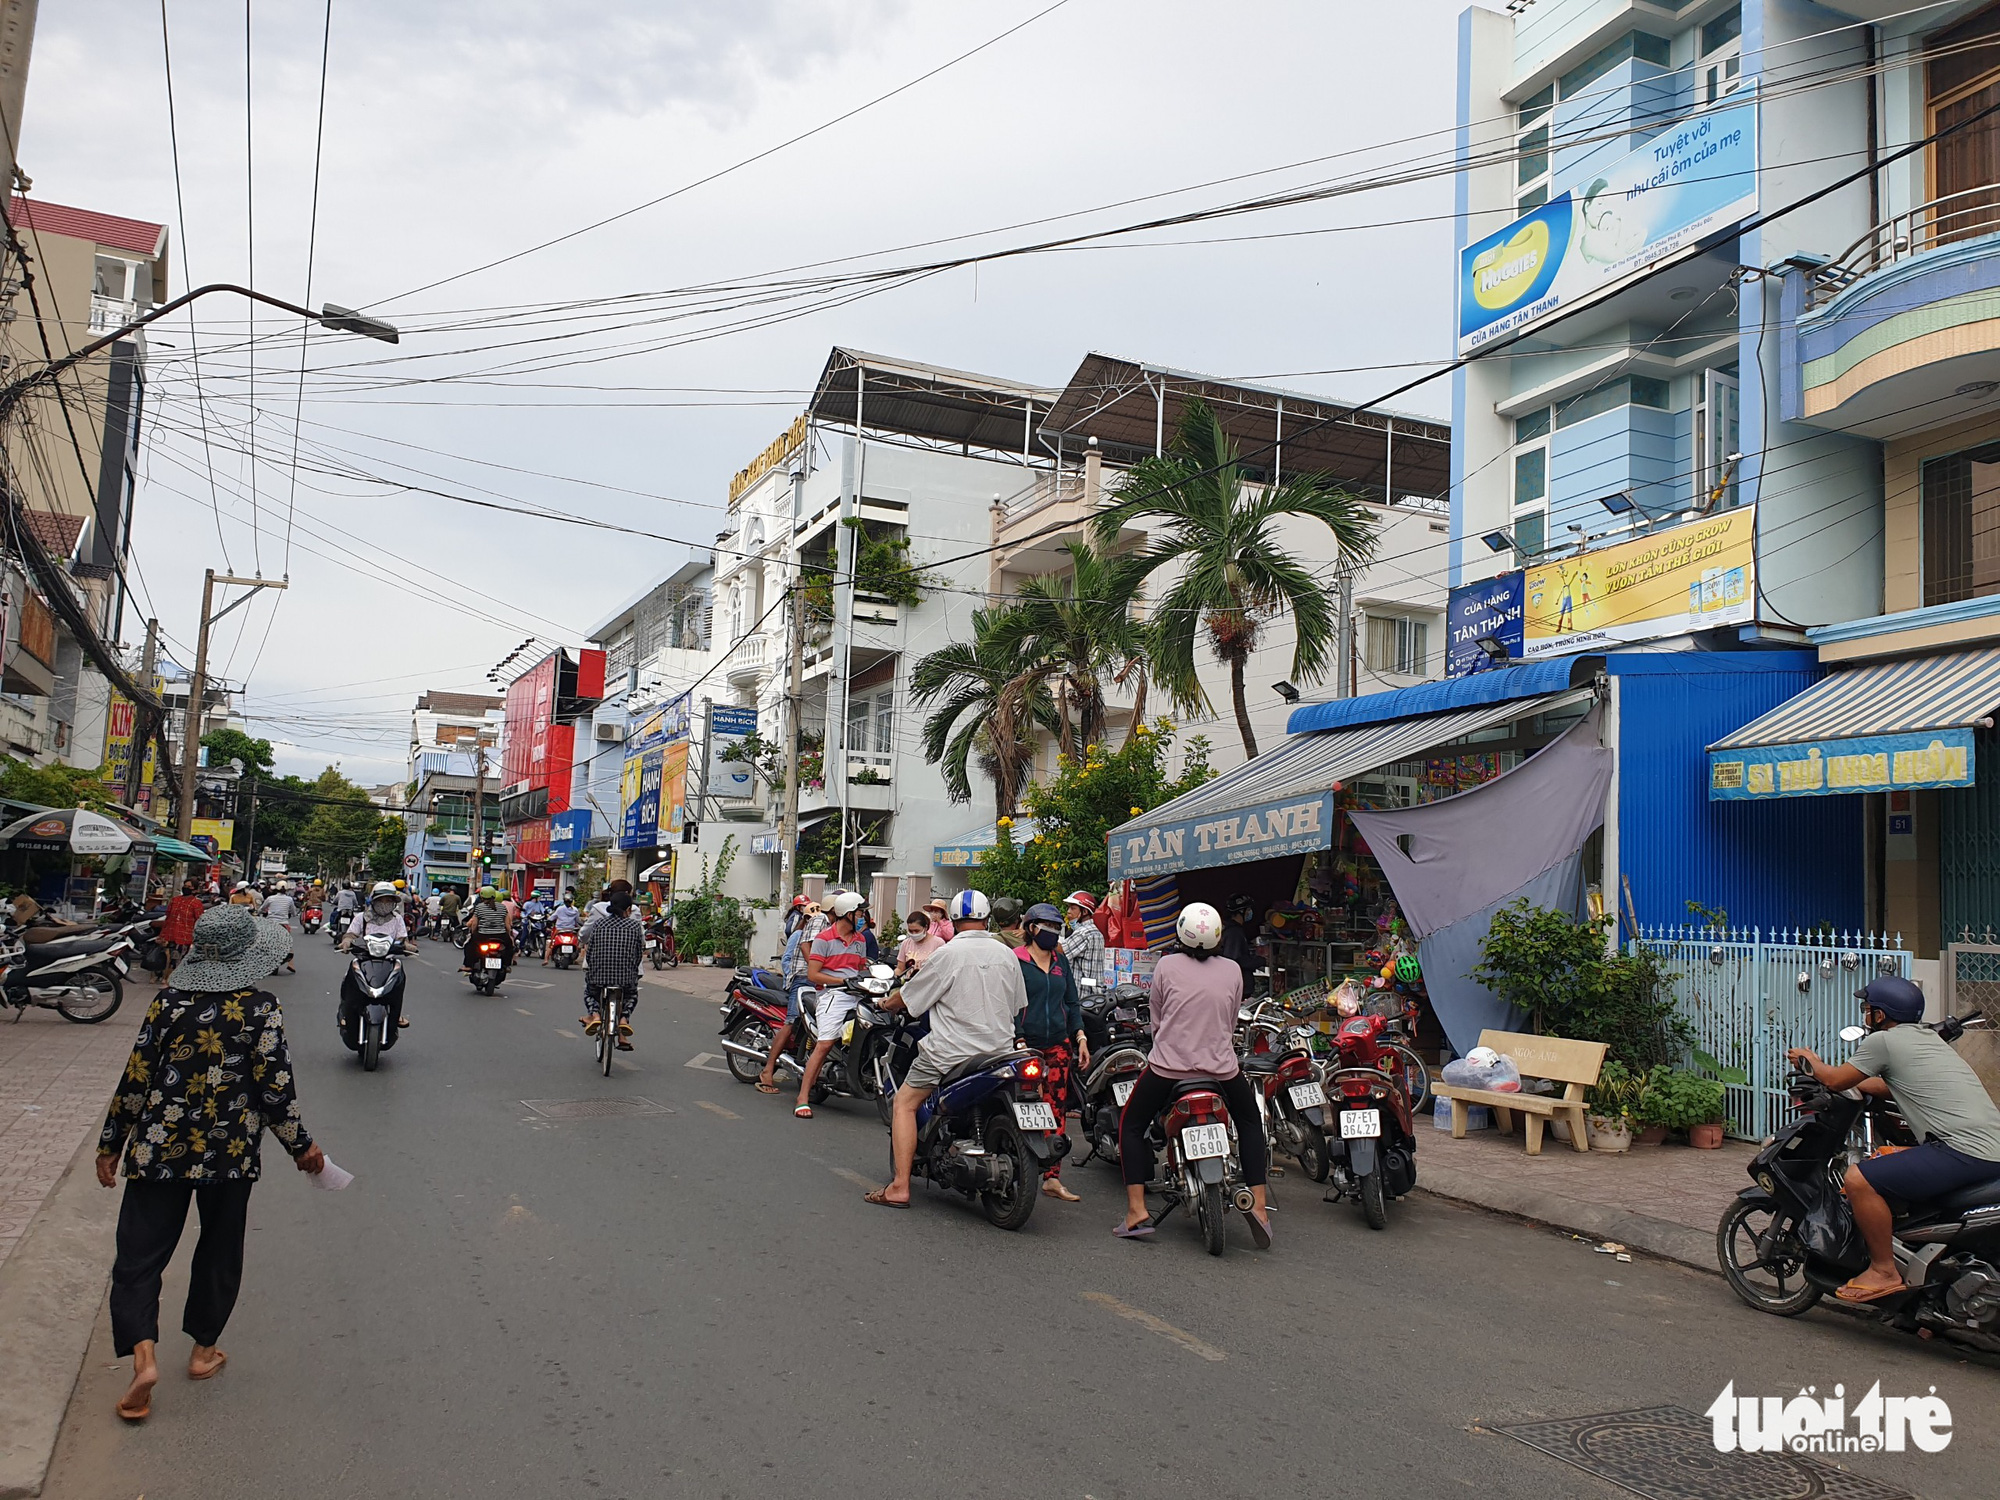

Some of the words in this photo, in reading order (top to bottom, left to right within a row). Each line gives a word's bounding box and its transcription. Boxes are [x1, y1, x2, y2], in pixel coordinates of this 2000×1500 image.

[1654, 134, 1689, 162] Tuyệt
[1691, 117, 1711, 141] vời
[1626, 178, 1650, 201] như
[1651, 166, 1669, 188] cái
[1671, 156, 1692, 176] ôm
[1694, 141, 1717, 164] của
[1720, 129, 1741, 150] mẹ
[1471, 329, 1487, 346] CỬA
[1489, 322, 1511, 338] HÀNG
[1512, 310, 1529, 326] TÂN
[1531, 295, 1560, 317] THANH
[1605, 560, 1628, 578] LỚN
[1628, 547, 1660, 570] KHÔN
[1659, 536, 1695, 557] CÙNG
[1695, 518, 1732, 541] GROW
[1638, 562, 1664, 582] TẦM
[1666, 547, 1692, 570] THẾ
[1692, 539, 1723, 561] GIỚI
[1464, 602, 1483, 616] CỬA
[1484, 590, 1510, 609] HÀNG
[1454, 624, 1478, 643] TÂN
[1480, 605, 1521, 634] THANH
[110, 702, 134, 738] KIM
[713, 715, 737, 725] HẠNH
[738, 717, 756, 726] BÍCH
[1747, 763, 1775, 794] 51
[1777, 747, 1823, 791] THỦ
[1892, 739, 1968, 785] HUÂN
[641, 769, 661, 796] HẠNH
[641, 798, 657, 825] BÍCH
[1895, 819, 1906, 829] 51
[1127, 826, 1186, 864] TÂN
[1193, 800, 1323, 852] THANH
[1512, 1047, 1535, 1060] NGỌC
[1538, 1051, 1558, 1063] ANH
[1020, 1104, 1046, 1116] 67-G1
[1296, 1095, 1321, 1107] 0765
[1343, 1123, 1377, 1136] 364.27
[1346, 1111, 1373, 1124] 67-E1
[1192, 1139, 1224, 1156] 8690
